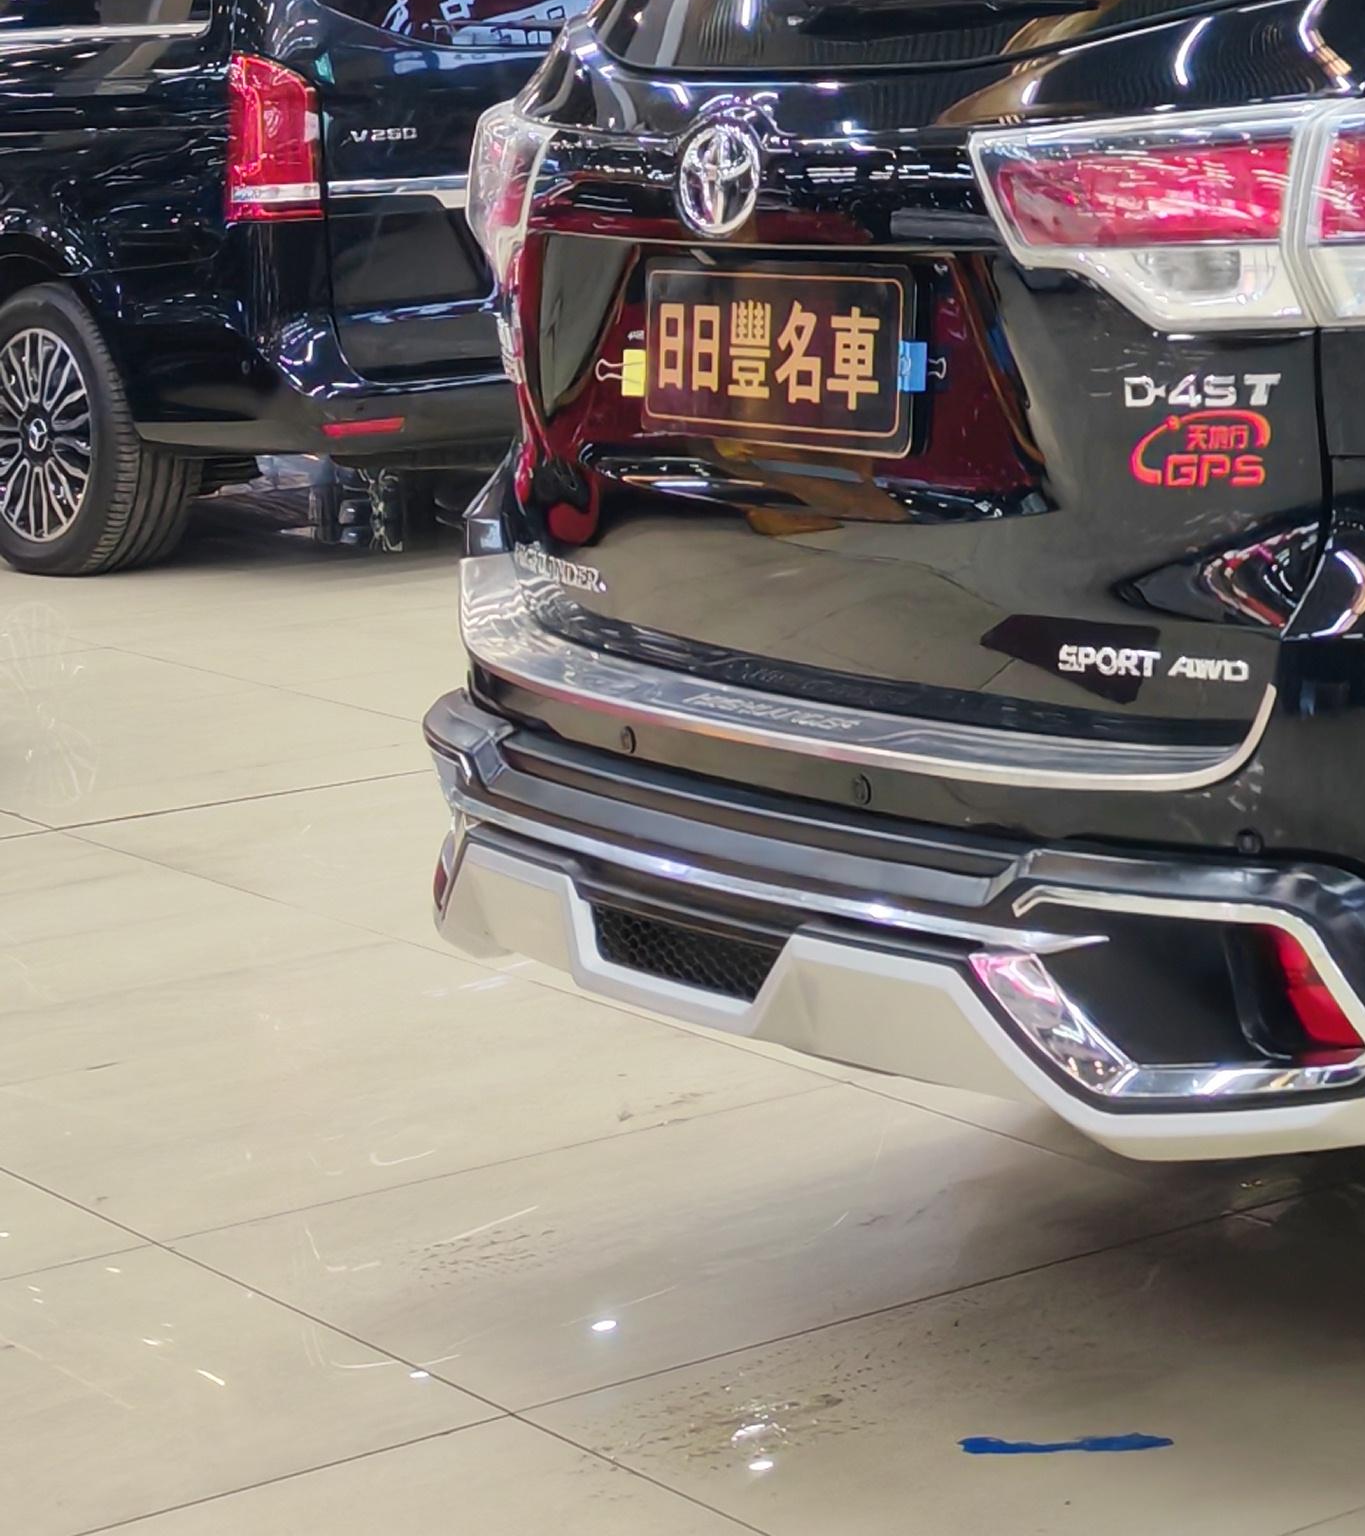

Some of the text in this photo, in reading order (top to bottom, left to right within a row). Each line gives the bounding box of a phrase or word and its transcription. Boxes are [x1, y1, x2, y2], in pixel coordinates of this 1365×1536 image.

[658, 299, 881, 411] 日日豐名車
[1165, 453, 1266, 488] GPS
[1057, 643, 1250, 682] SPORT AWD
